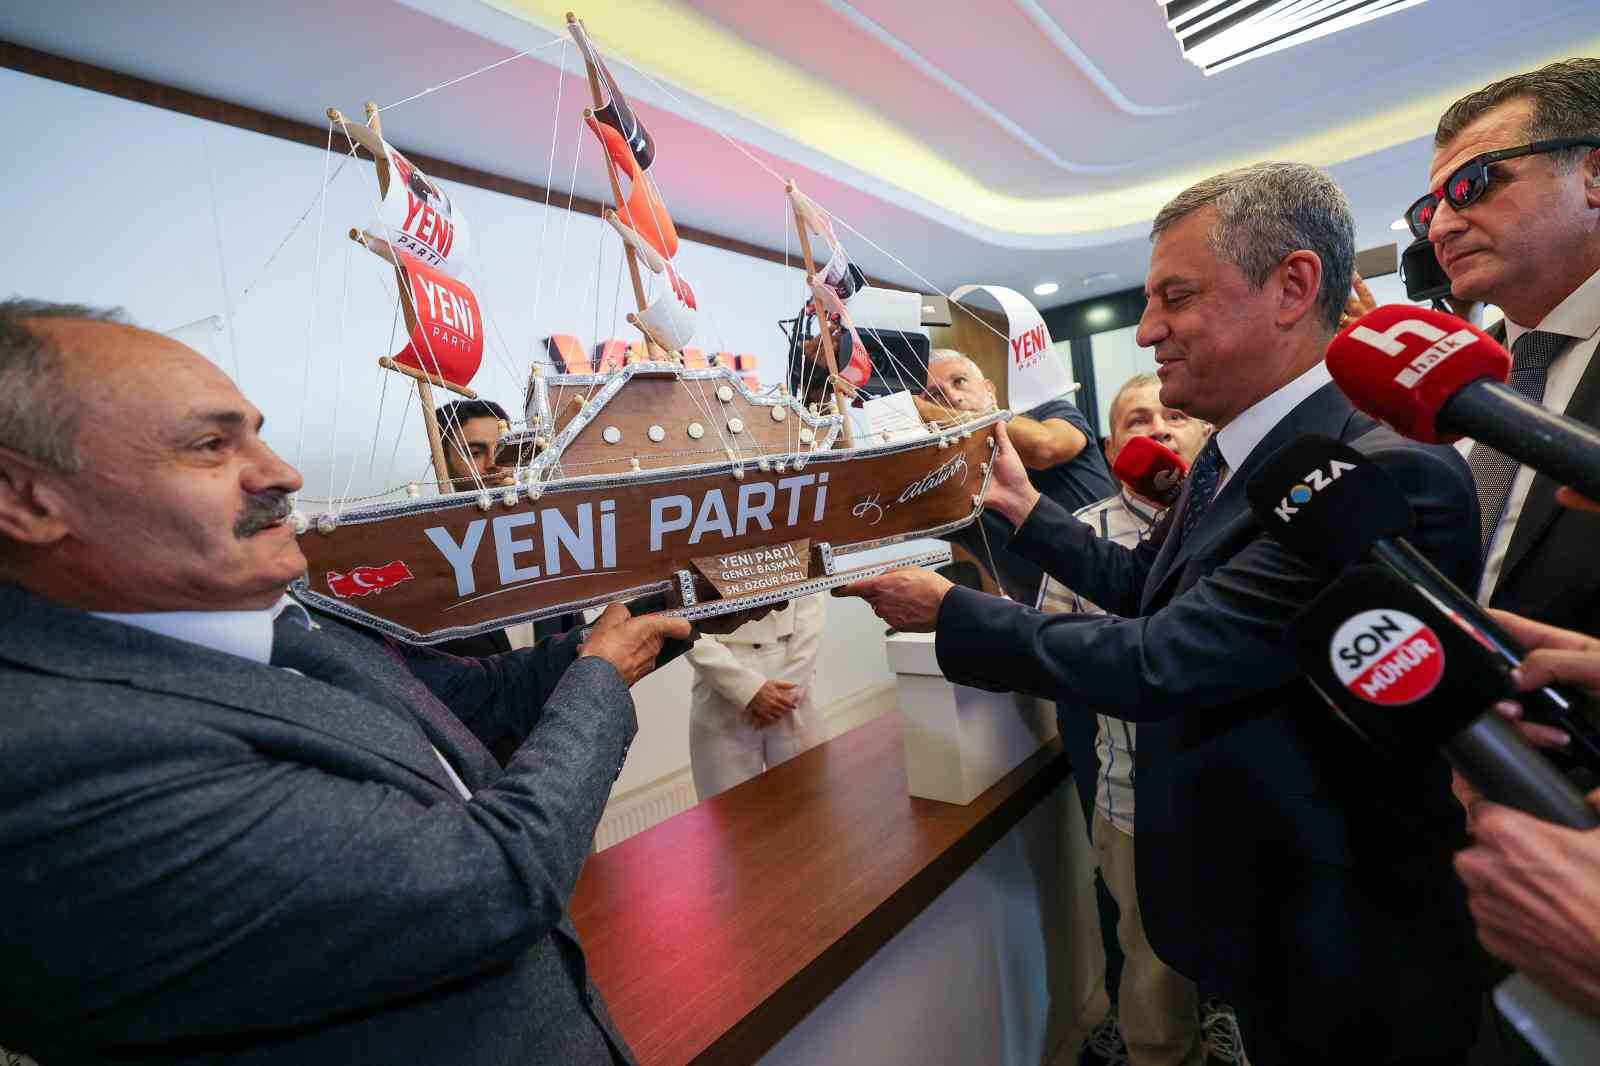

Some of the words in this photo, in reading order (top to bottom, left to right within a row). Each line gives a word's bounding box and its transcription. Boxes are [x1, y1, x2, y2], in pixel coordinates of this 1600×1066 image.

[1274, 459, 1358, 522] KOZA
[721, 566, 756, 580] GENEL
[1338, 614, 1403, 670] SON
